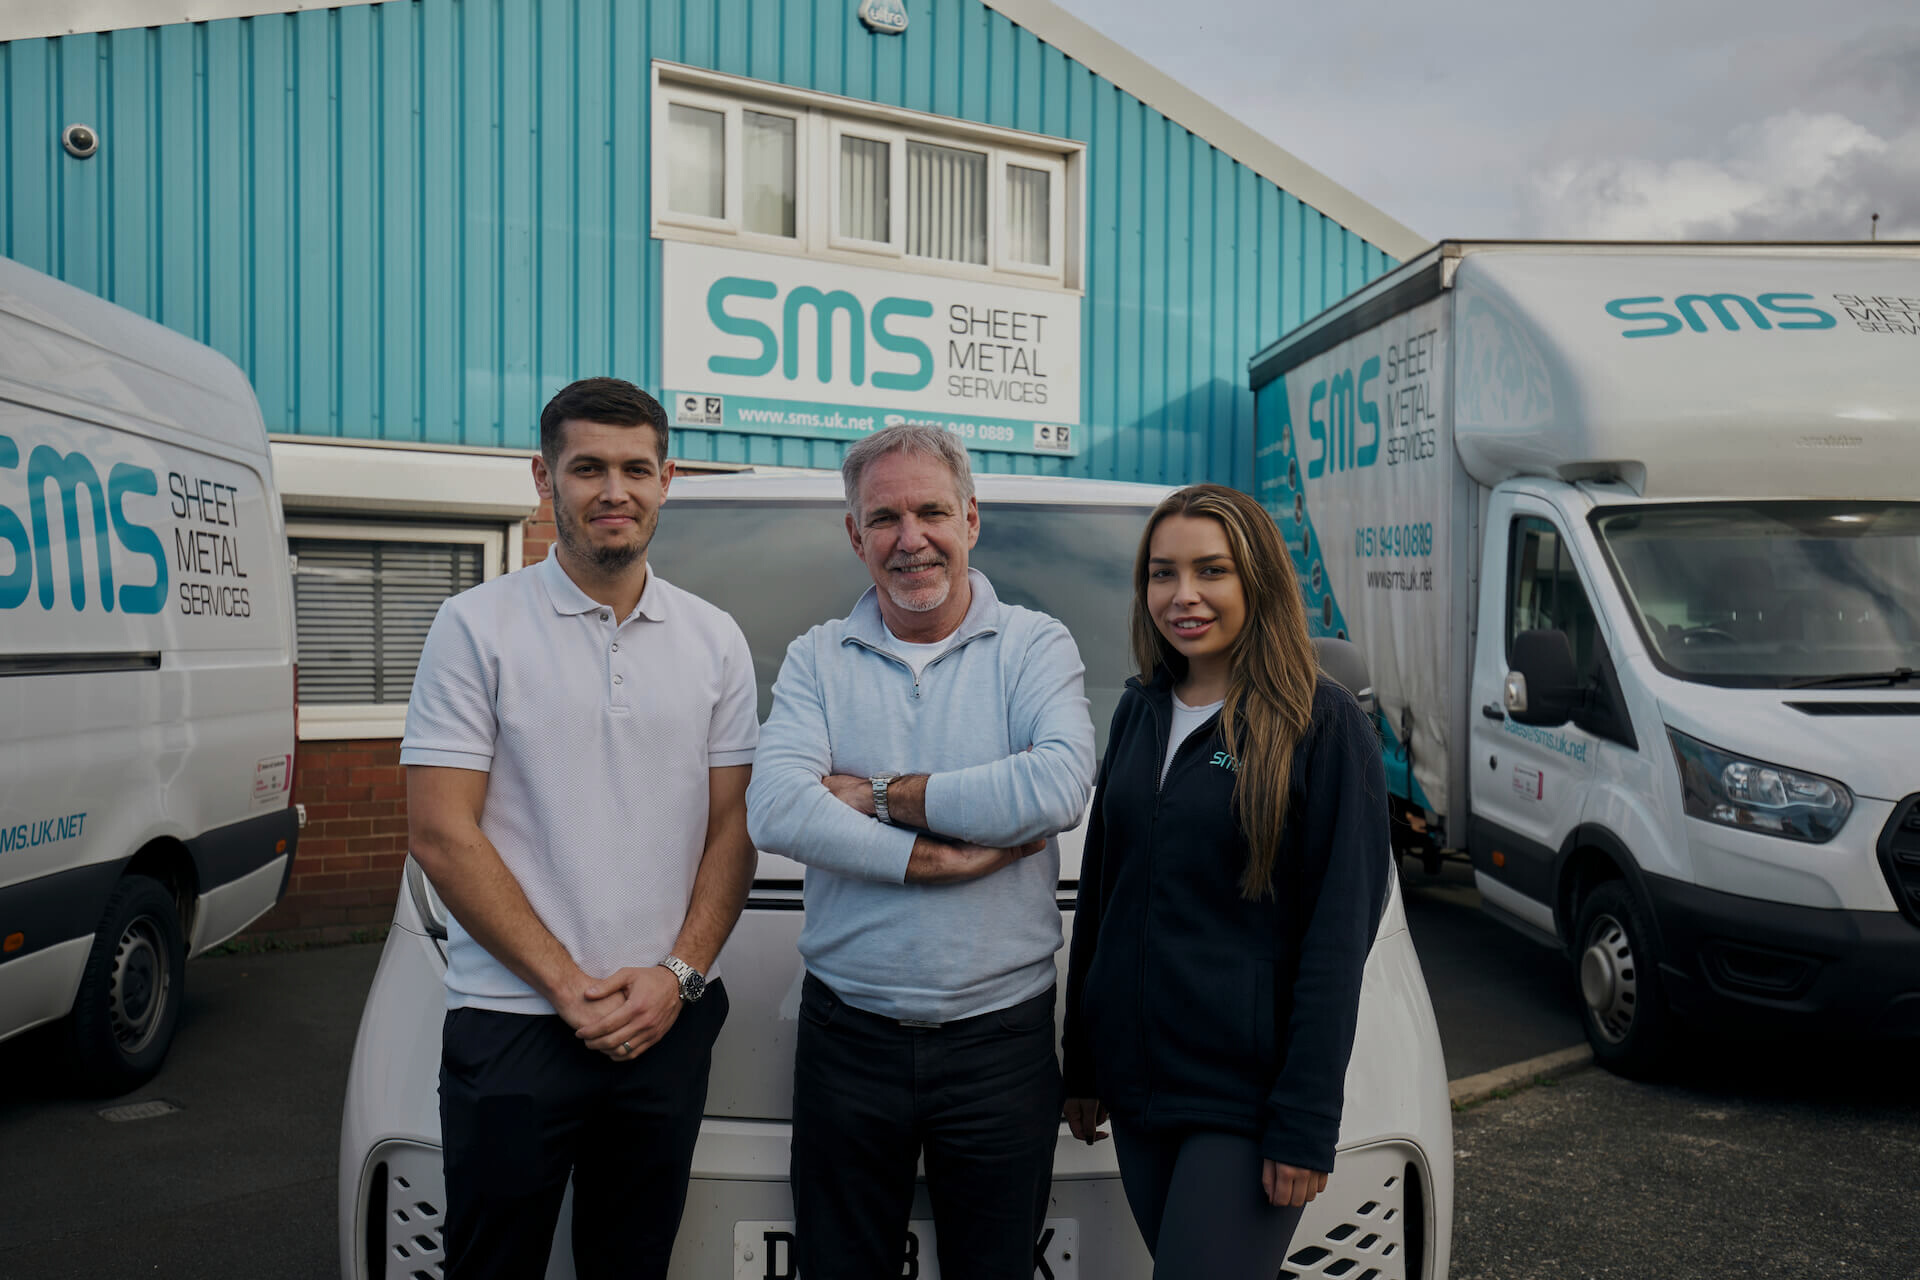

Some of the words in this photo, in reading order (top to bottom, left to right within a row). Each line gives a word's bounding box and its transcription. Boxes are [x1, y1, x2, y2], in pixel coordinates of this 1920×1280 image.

[1832, 293, 1920, 311] SHEE
[1844, 307, 1920, 323] MET
[949, 304, 1049, 343] SHEET
[1856, 321, 1920, 335] SERV
[948, 339, 1049, 378] METAL
[1387, 328, 1438, 385] SHEET
[947, 375, 1049, 405] SERVICES
[1387, 381, 1436, 430] METAL
[737, 407, 875, 431] www.sms.uk.net
[978, 424, 1014, 442] 0889
[1387, 428, 1436, 466] SERVICES
[168, 471, 238, 528] SHEET
[174, 527, 248, 579] METAL
[1403, 521, 1433, 557] 0889
[179, 583, 251, 618] SERVICES
